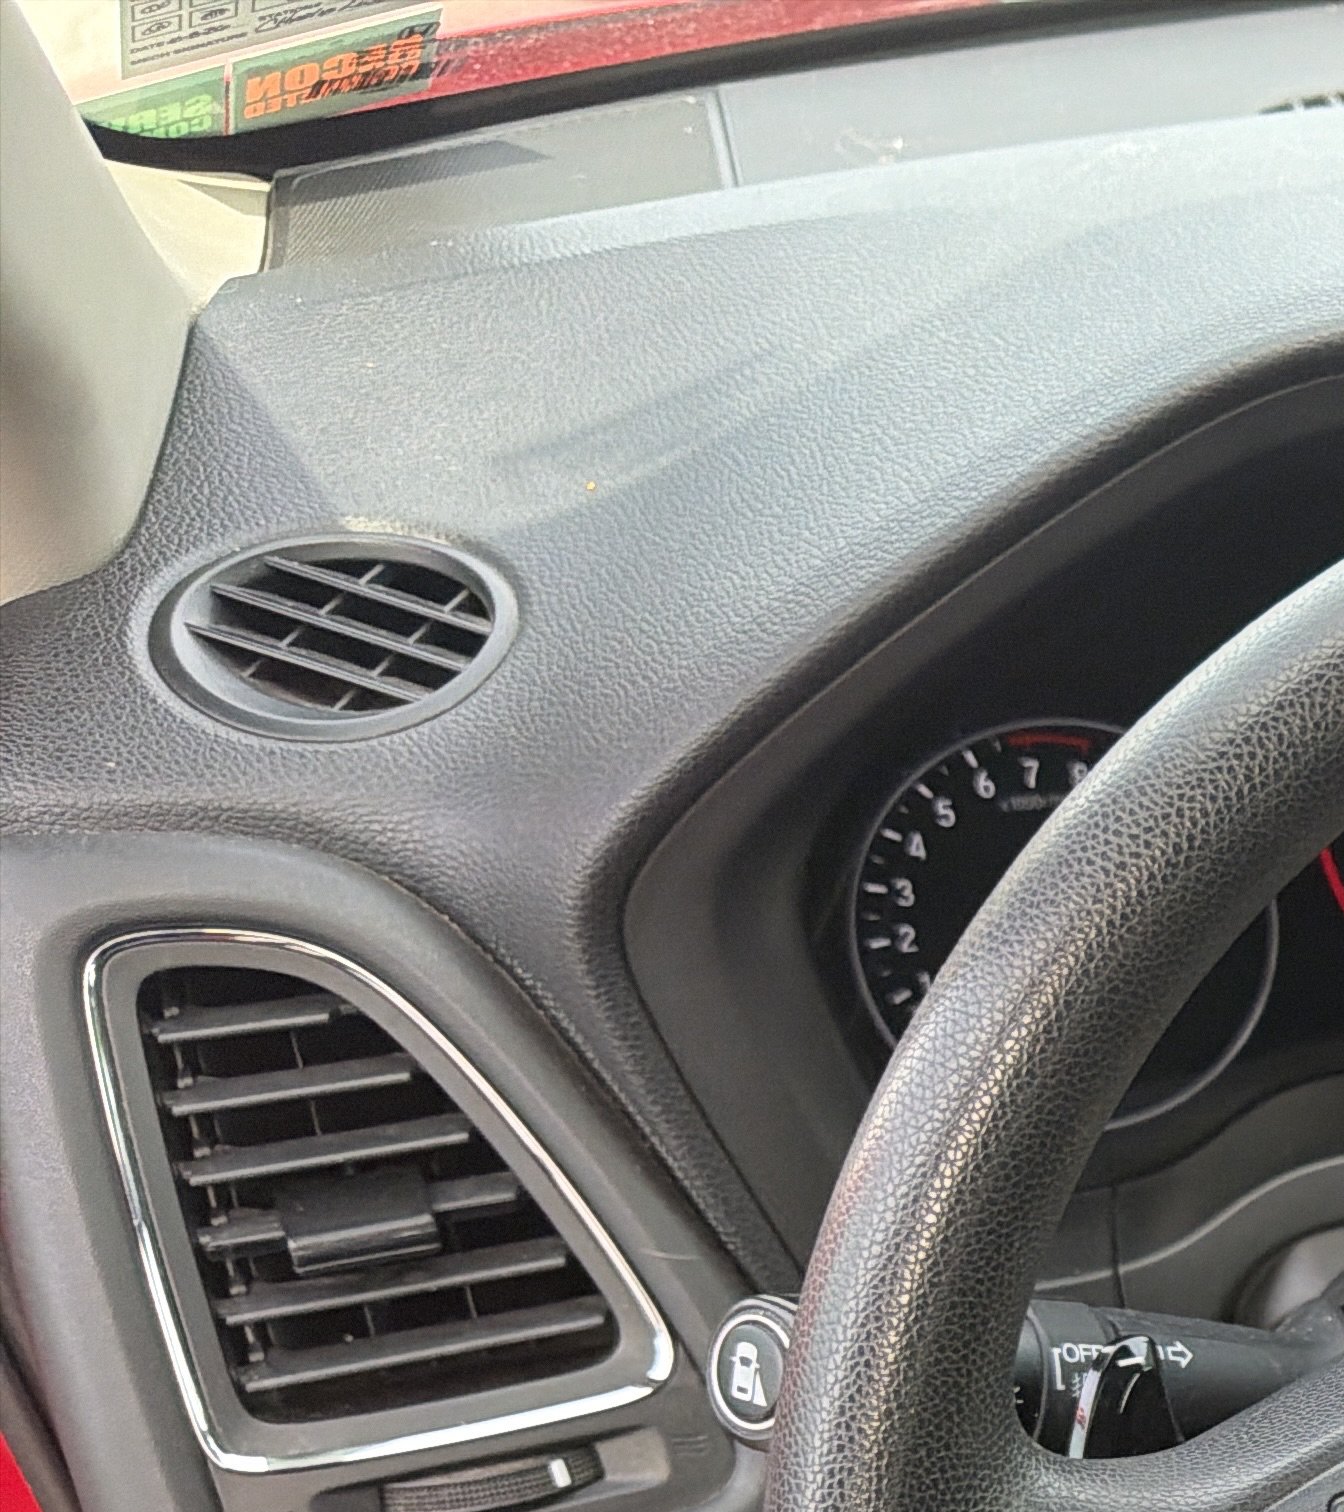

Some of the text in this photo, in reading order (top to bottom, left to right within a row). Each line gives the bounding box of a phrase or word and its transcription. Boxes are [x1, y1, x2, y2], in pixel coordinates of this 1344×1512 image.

[973, 767, 996, 799] 6
[1019, 757, 1039, 789] 7
[933, 797, 955, 828] 5
[906, 831, 927, 860] 4
[894, 879, 914, 907] 3
[895, 925, 918, 953] 2
[1062, 1343, 1103, 1363] OFF
